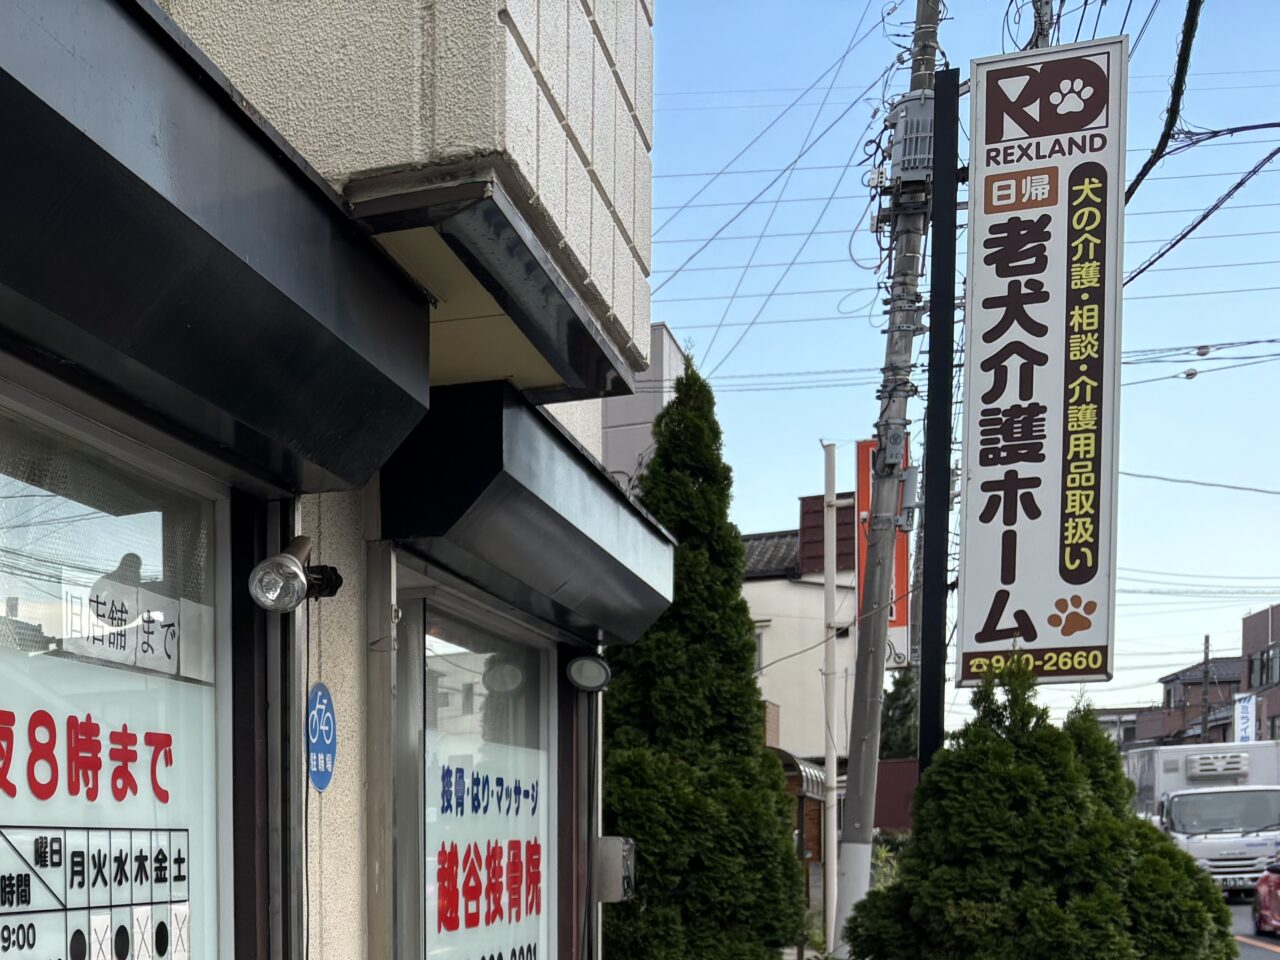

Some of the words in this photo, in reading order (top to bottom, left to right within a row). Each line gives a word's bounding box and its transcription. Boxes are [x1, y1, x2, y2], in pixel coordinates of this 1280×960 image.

[985, 133, 1107, 167] REXLAND
[991, 173, 1050, 206] 日帰
[1064, 177, 1102, 570] 犬の介護・相談・介護用品取扱い
[975, 213, 1052, 644] 老犬介護ホーム
[441, 765, 539, 817] 接骨・はり・マッサージ
[34, 836, 63, 868] 曜日
[70, 850, 86, 889] 月
[91, 849, 108, 887] 火
[113, 849, 130, 886] 水
[134, 849, 149, 885] 木
[154, 848, 169, 883] 金
[173, 848, 186, 882] 土
[0, 873, 31, 907] 時間
[436, 836, 542, 934] 越谷接骨院
[0, 922, 36, 952] 9:00
